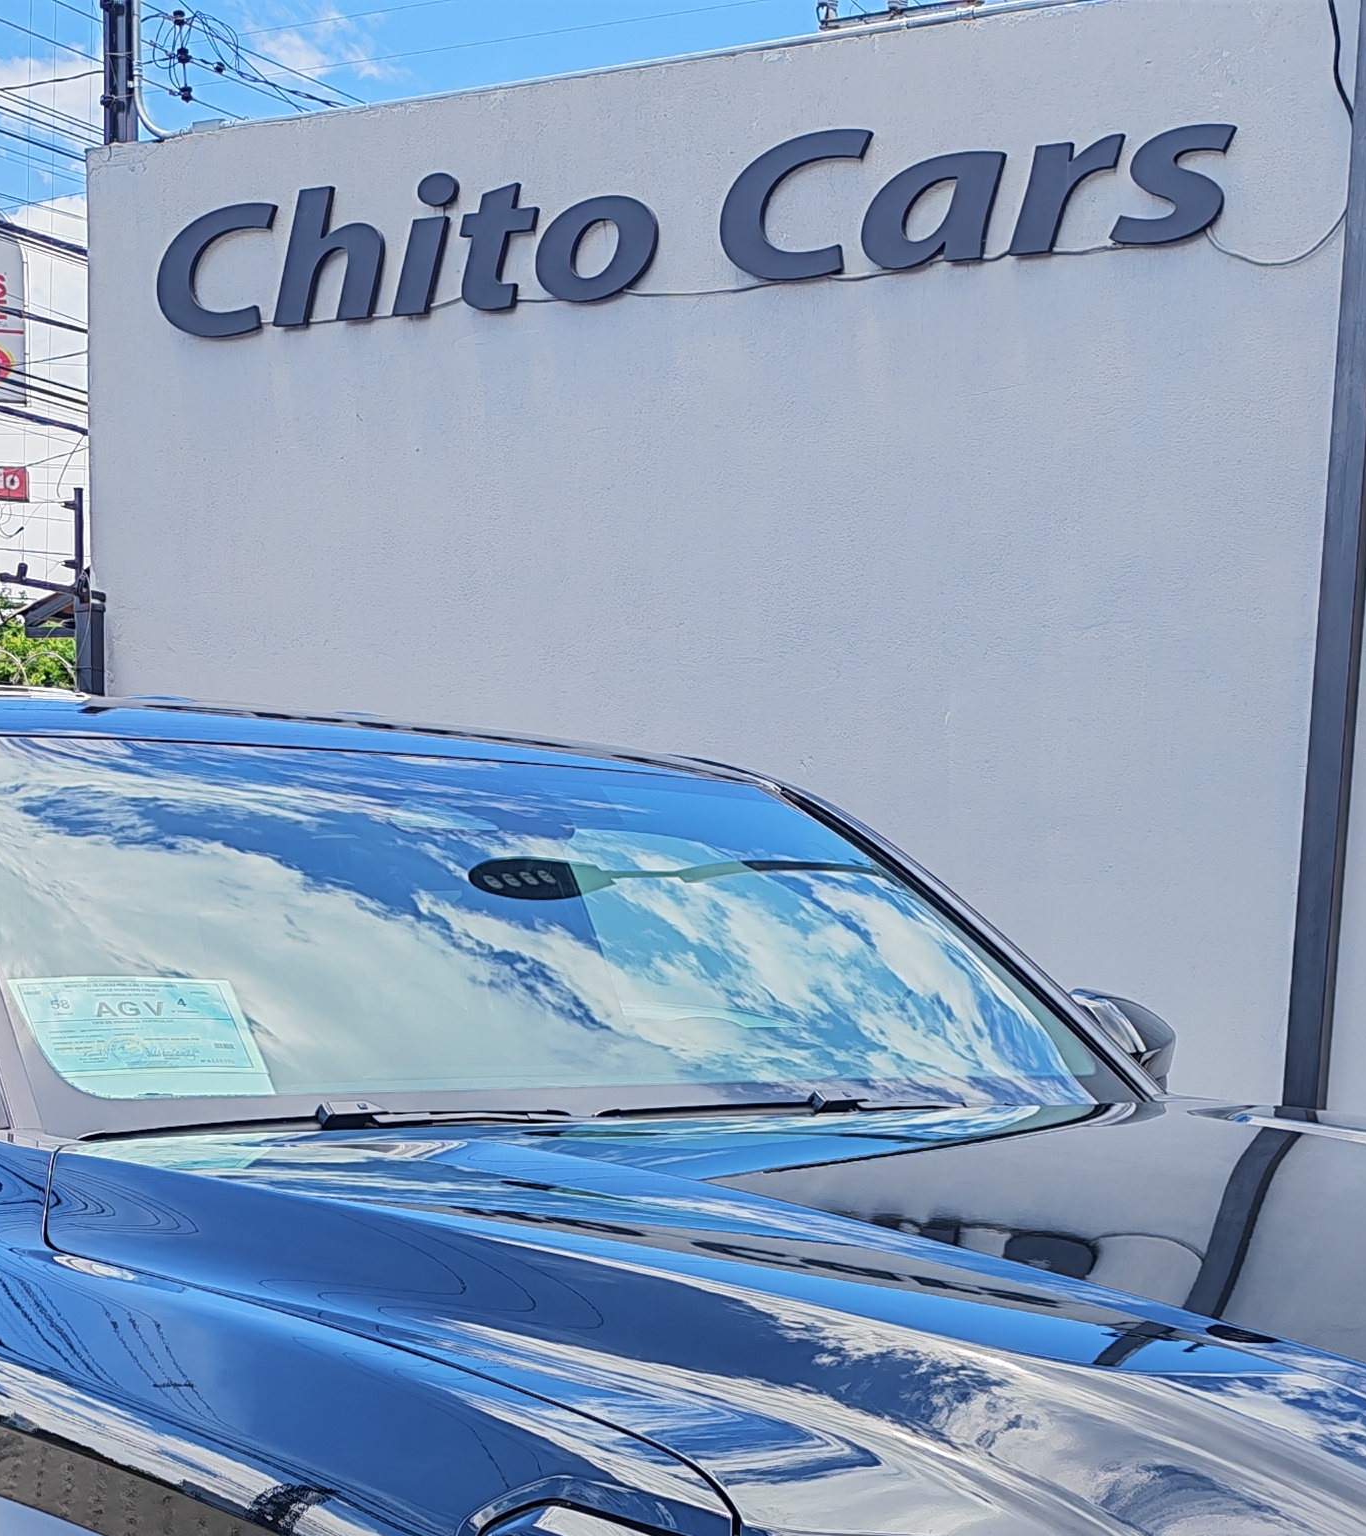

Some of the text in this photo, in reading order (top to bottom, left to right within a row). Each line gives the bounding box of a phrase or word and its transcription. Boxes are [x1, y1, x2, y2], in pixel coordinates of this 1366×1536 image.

[156, 123, 1238, 341] Chito Cars
[50, 998, 71, 1010] 58
[96, 1000, 164, 1018] AGV
[176, 997, 187, 1008] 4
